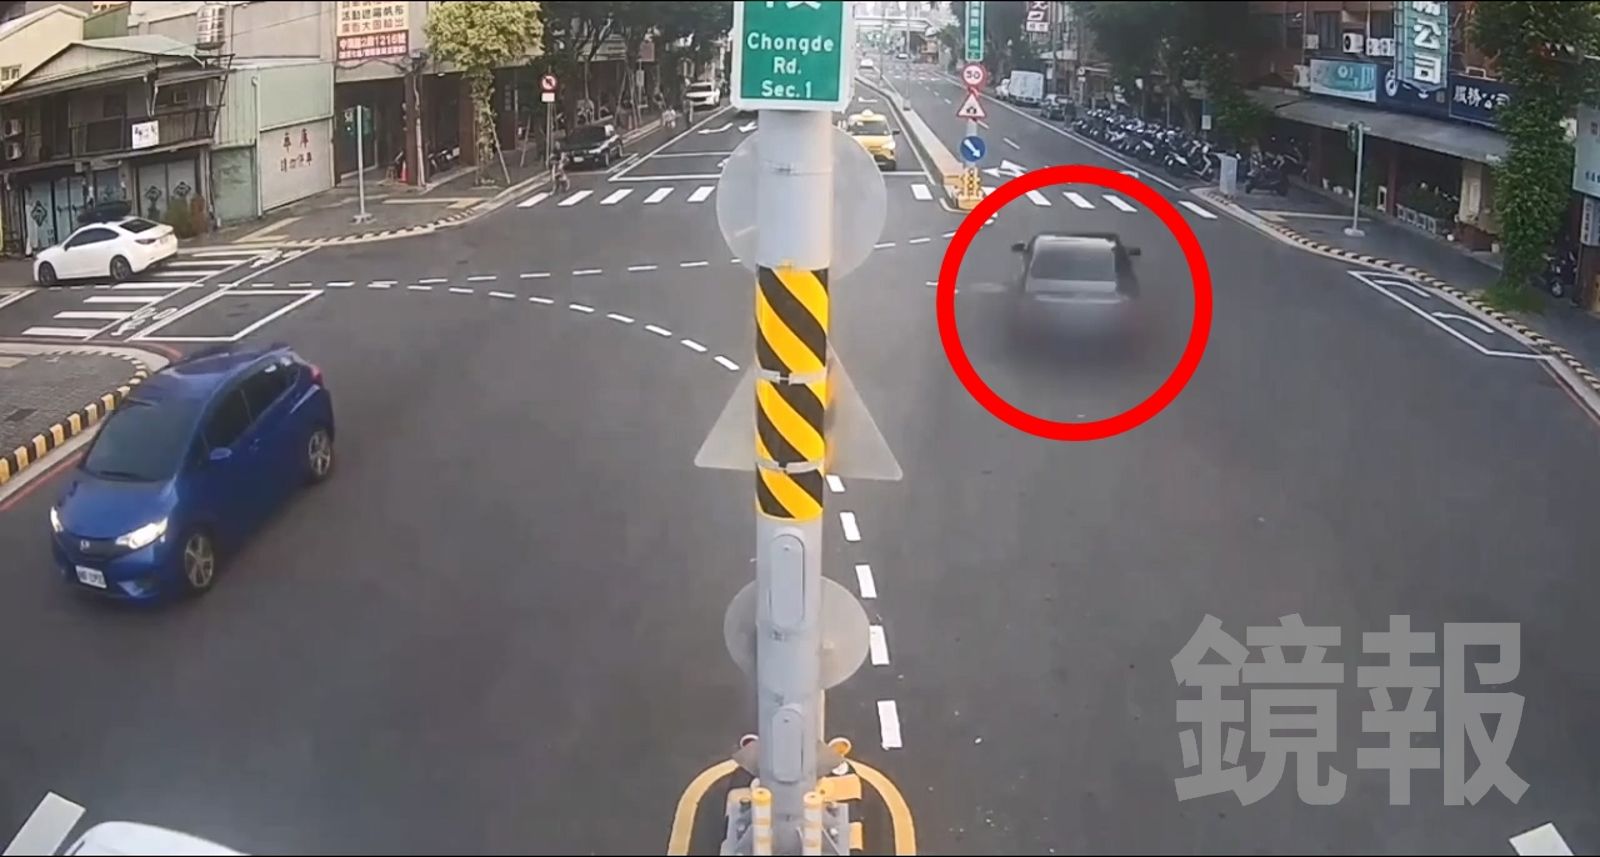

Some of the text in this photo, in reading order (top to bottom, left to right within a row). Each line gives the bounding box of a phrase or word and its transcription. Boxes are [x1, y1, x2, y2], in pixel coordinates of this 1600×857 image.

[747, 32, 834, 55] Chongde
[773, 57, 801, 74] Rd.
[966, 71, 981, 79] 50
